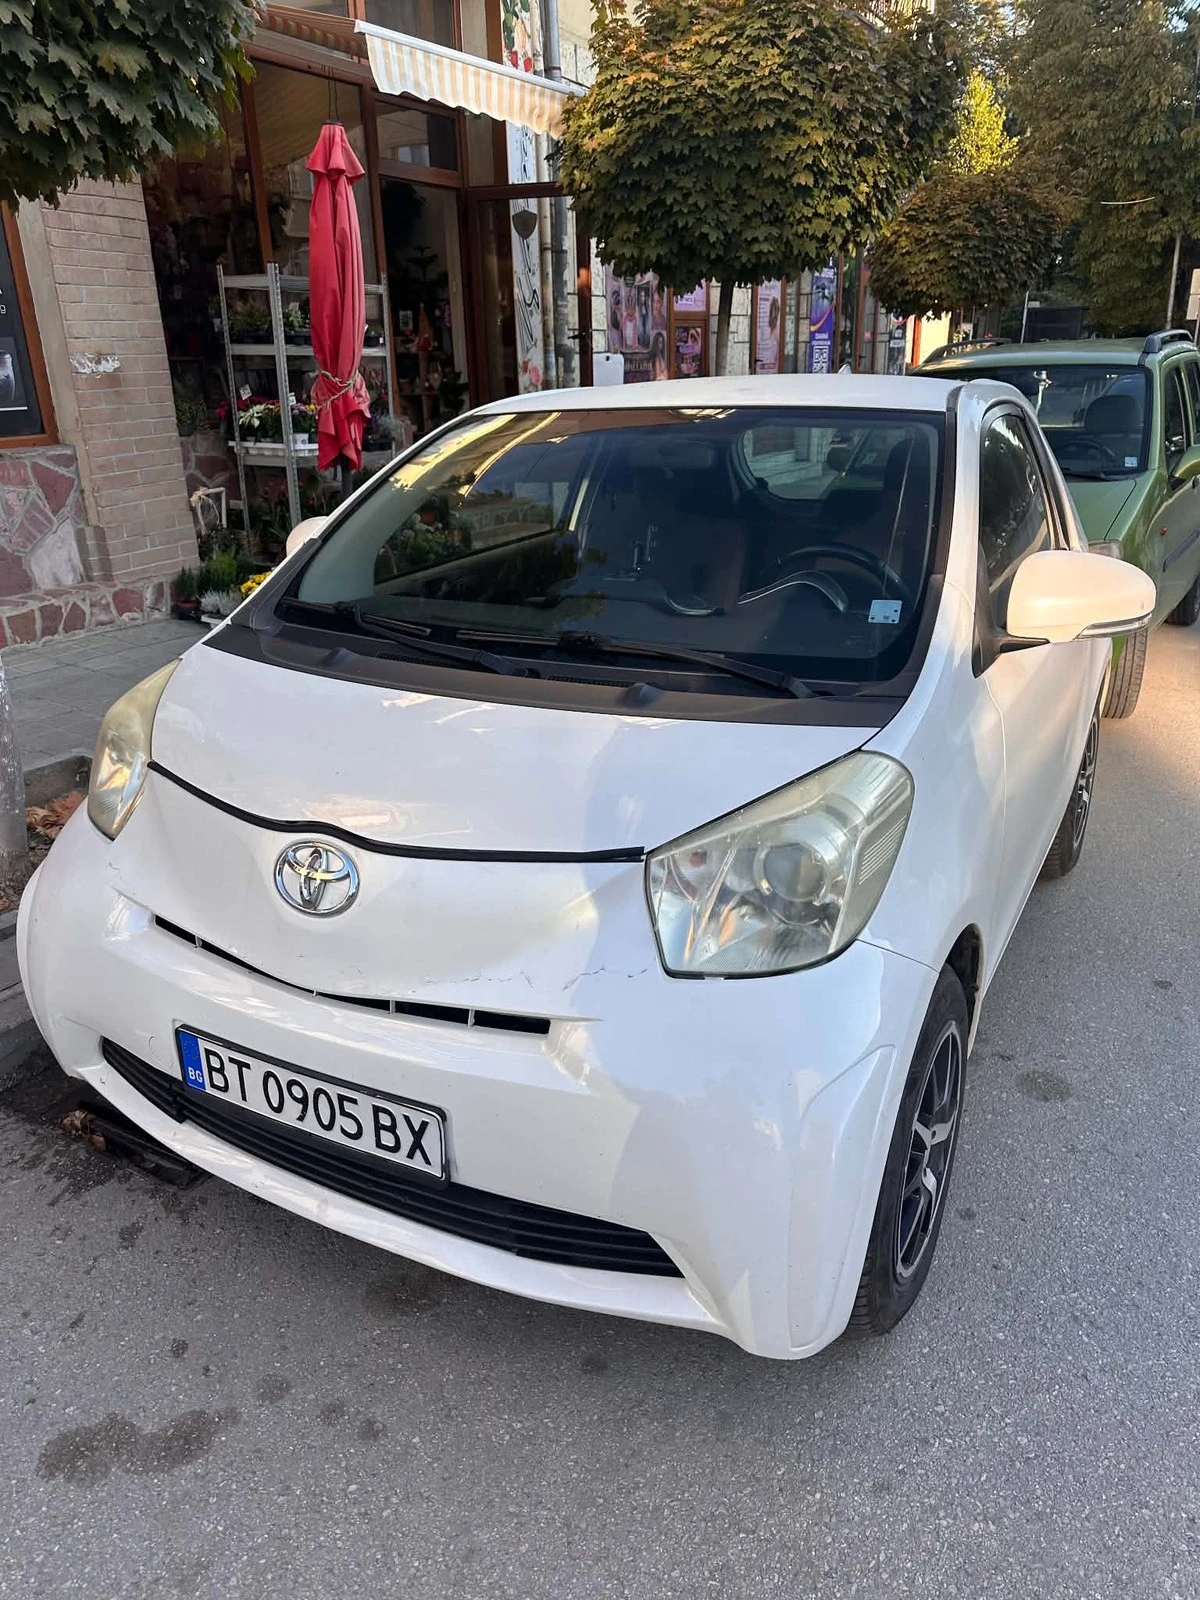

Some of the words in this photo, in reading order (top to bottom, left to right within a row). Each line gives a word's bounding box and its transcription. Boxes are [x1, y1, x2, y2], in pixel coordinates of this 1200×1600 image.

[188, 1066, 203, 1082] BG
[204, 1047, 251, 1102] BT
[262, 1070, 363, 1140] 0905
[371, 1103, 432, 1166] BX
